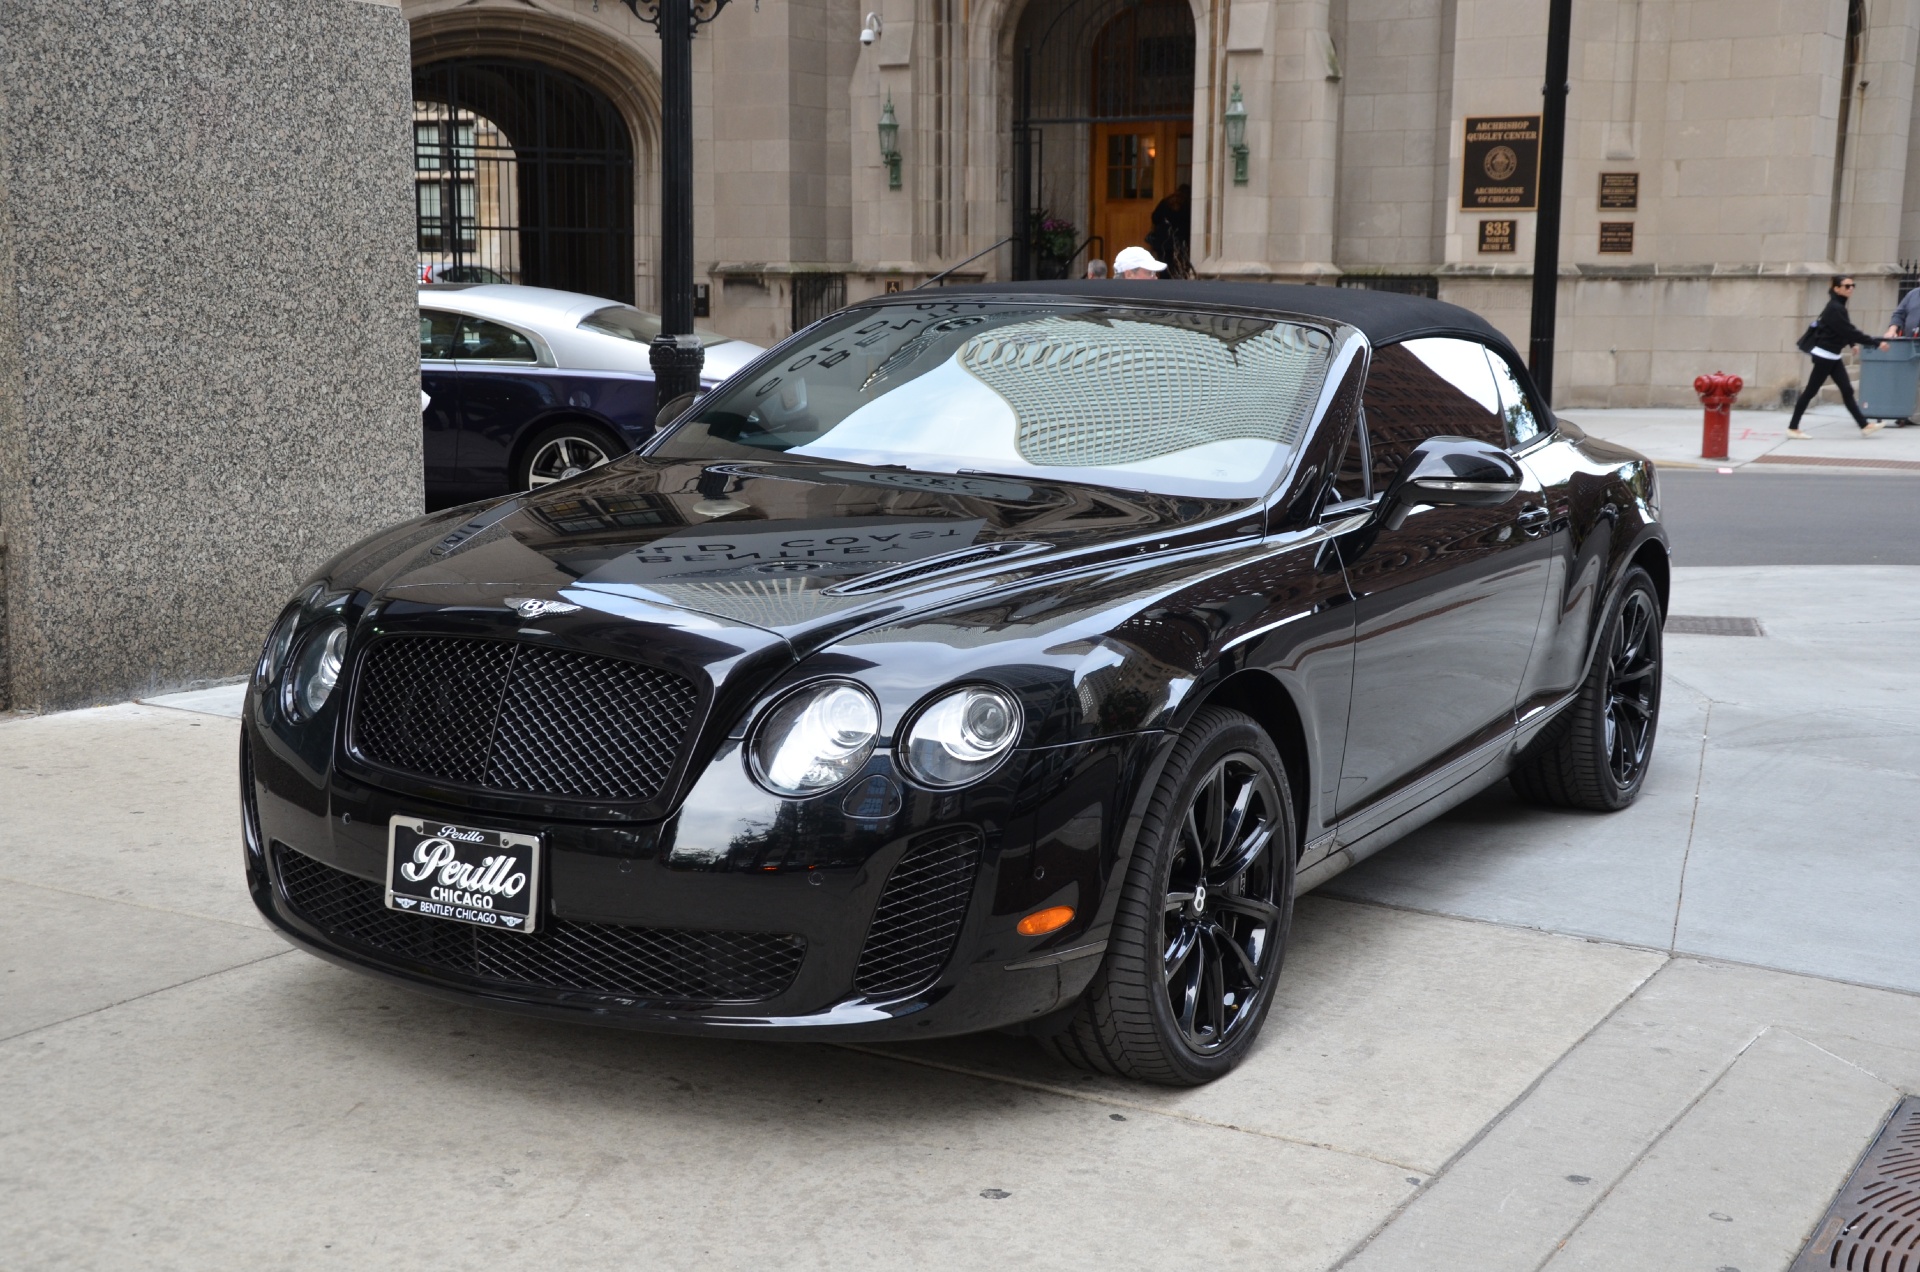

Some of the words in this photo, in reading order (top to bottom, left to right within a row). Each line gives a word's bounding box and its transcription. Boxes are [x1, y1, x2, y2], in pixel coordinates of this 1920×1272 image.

[1476, 121, 1529, 130] ARCHBISHOP
[1467, 132, 1502, 142] QUIGLEY
[1503, 131, 1537, 139] CENTER
[1485, 222, 1510, 236] 835
[437, 825, 485, 843] Perillo
[401, 837, 526, 899] Perillo
[430, 886, 494, 909] CHICAGO
[420, 901, 454, 917] BENTLEY
[455, 909, 497, 925] CHICAGO
